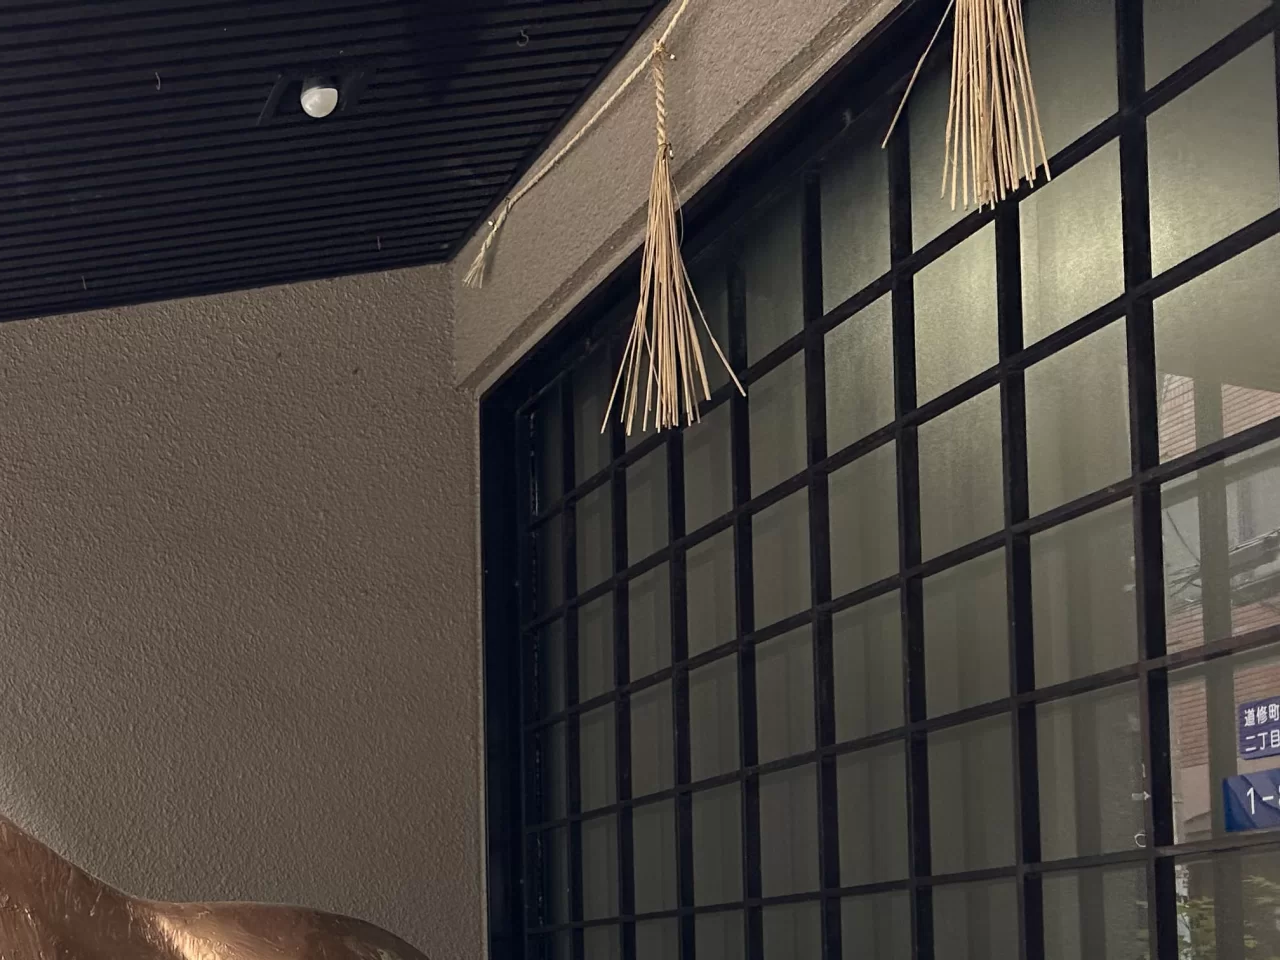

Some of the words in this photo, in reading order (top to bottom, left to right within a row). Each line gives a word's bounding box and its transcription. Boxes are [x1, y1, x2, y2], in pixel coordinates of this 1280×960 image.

[1244, 703, 1280, 727] 道修町
[1245, 728, 1280, 752] 二丁目
[1246, 785, 1280, 816] 1-
